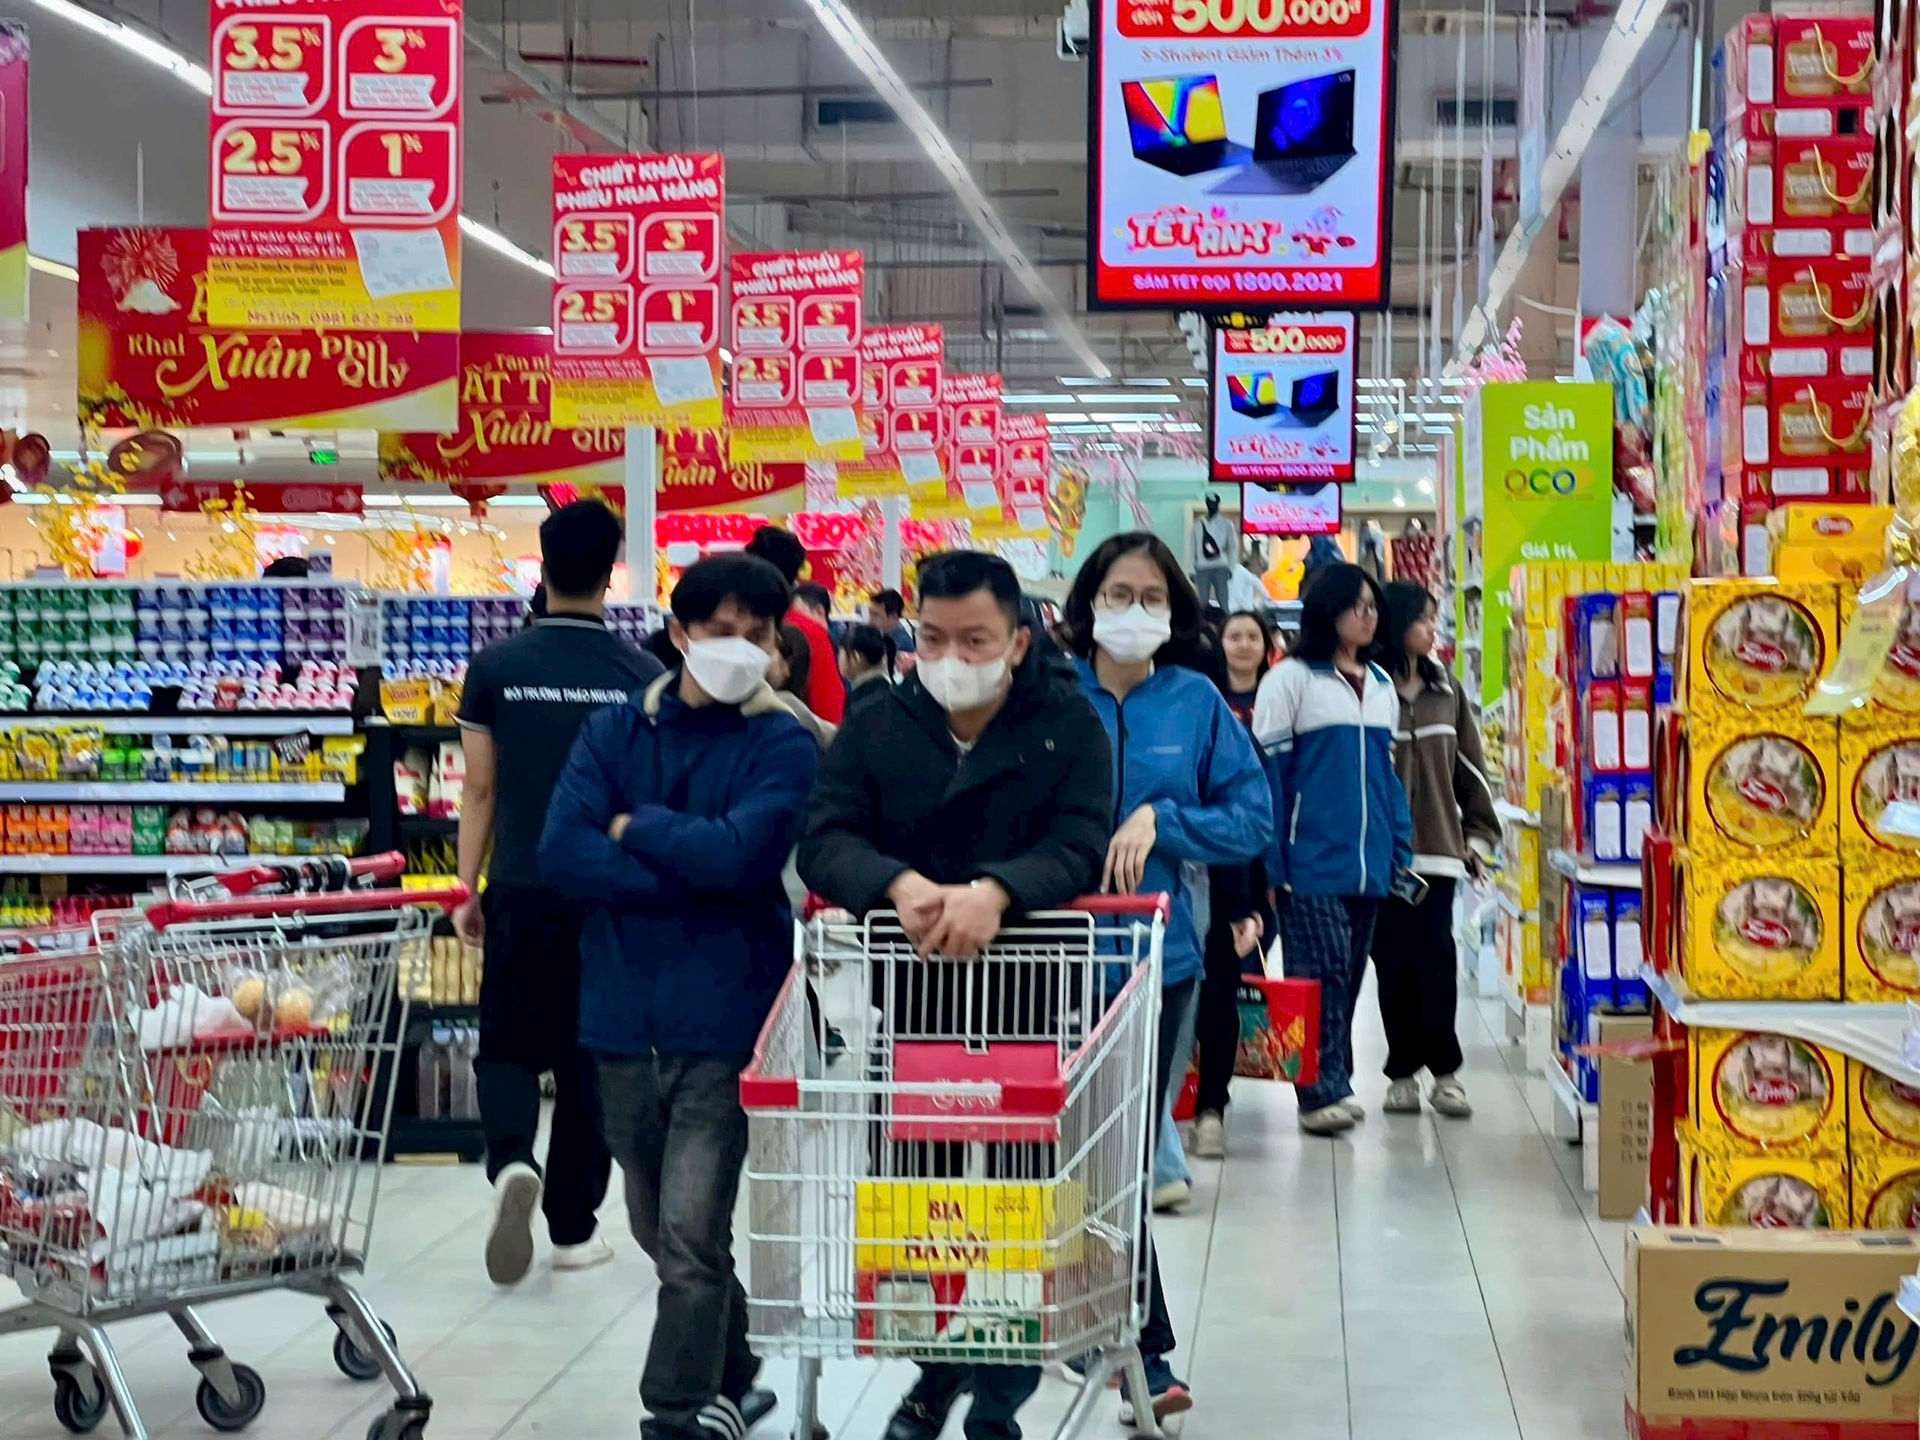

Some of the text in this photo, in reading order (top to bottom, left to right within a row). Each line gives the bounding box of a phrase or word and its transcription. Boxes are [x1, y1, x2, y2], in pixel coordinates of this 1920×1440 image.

[225, 25, 321, 71] 3.5%
[373, 28, 426, 73] 3%
[223, 129, 320, 175] 2.5%
[379, 132, 423, 176] 1%
[615, 184, 660, 205] MUA
[563, 221, 628, 252] 3.5%
[662, 220, 699, 251] 3%
[562, 291, 628, 323] 2.5%
[666, 290, 697, 322] 1%
[155, 332, 312, 395] Xuân
[1523, 402, 1576, 431] Sản
[1509, 432, 1590, 462] Phẩm
[928, 1199, 965, 1222] BIA
[1673, 1276, 1920, 1387] Emily
